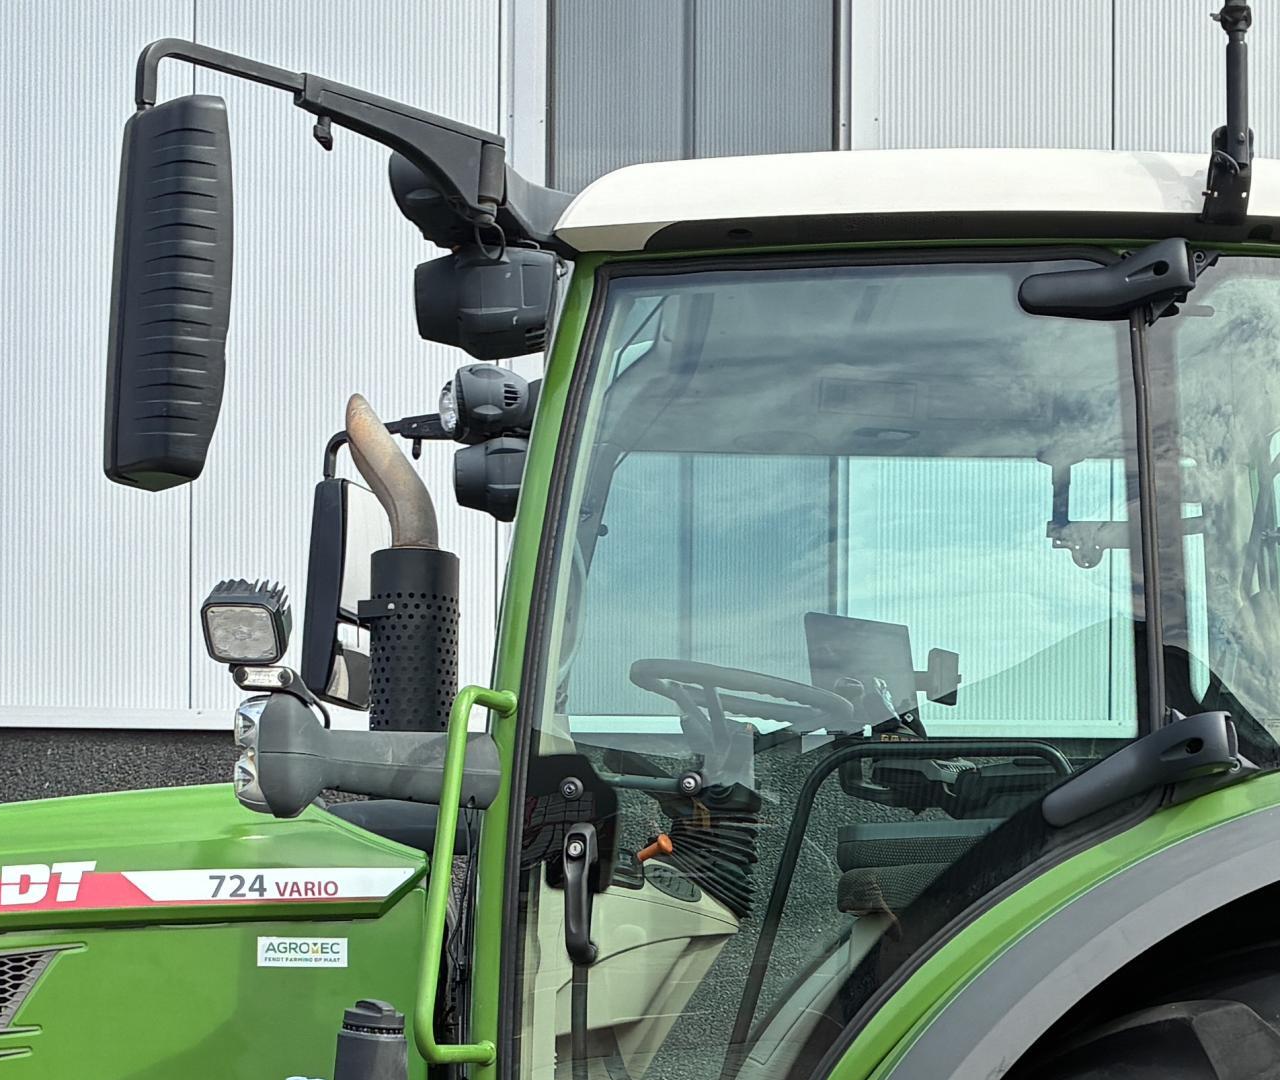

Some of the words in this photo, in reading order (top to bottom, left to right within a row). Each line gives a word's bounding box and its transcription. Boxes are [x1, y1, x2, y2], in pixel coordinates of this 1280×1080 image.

[209, 874, 267, 899] 724
[276, 880, 339, 898] VARIO
[265, 942, 340, 955] AGROTEC
